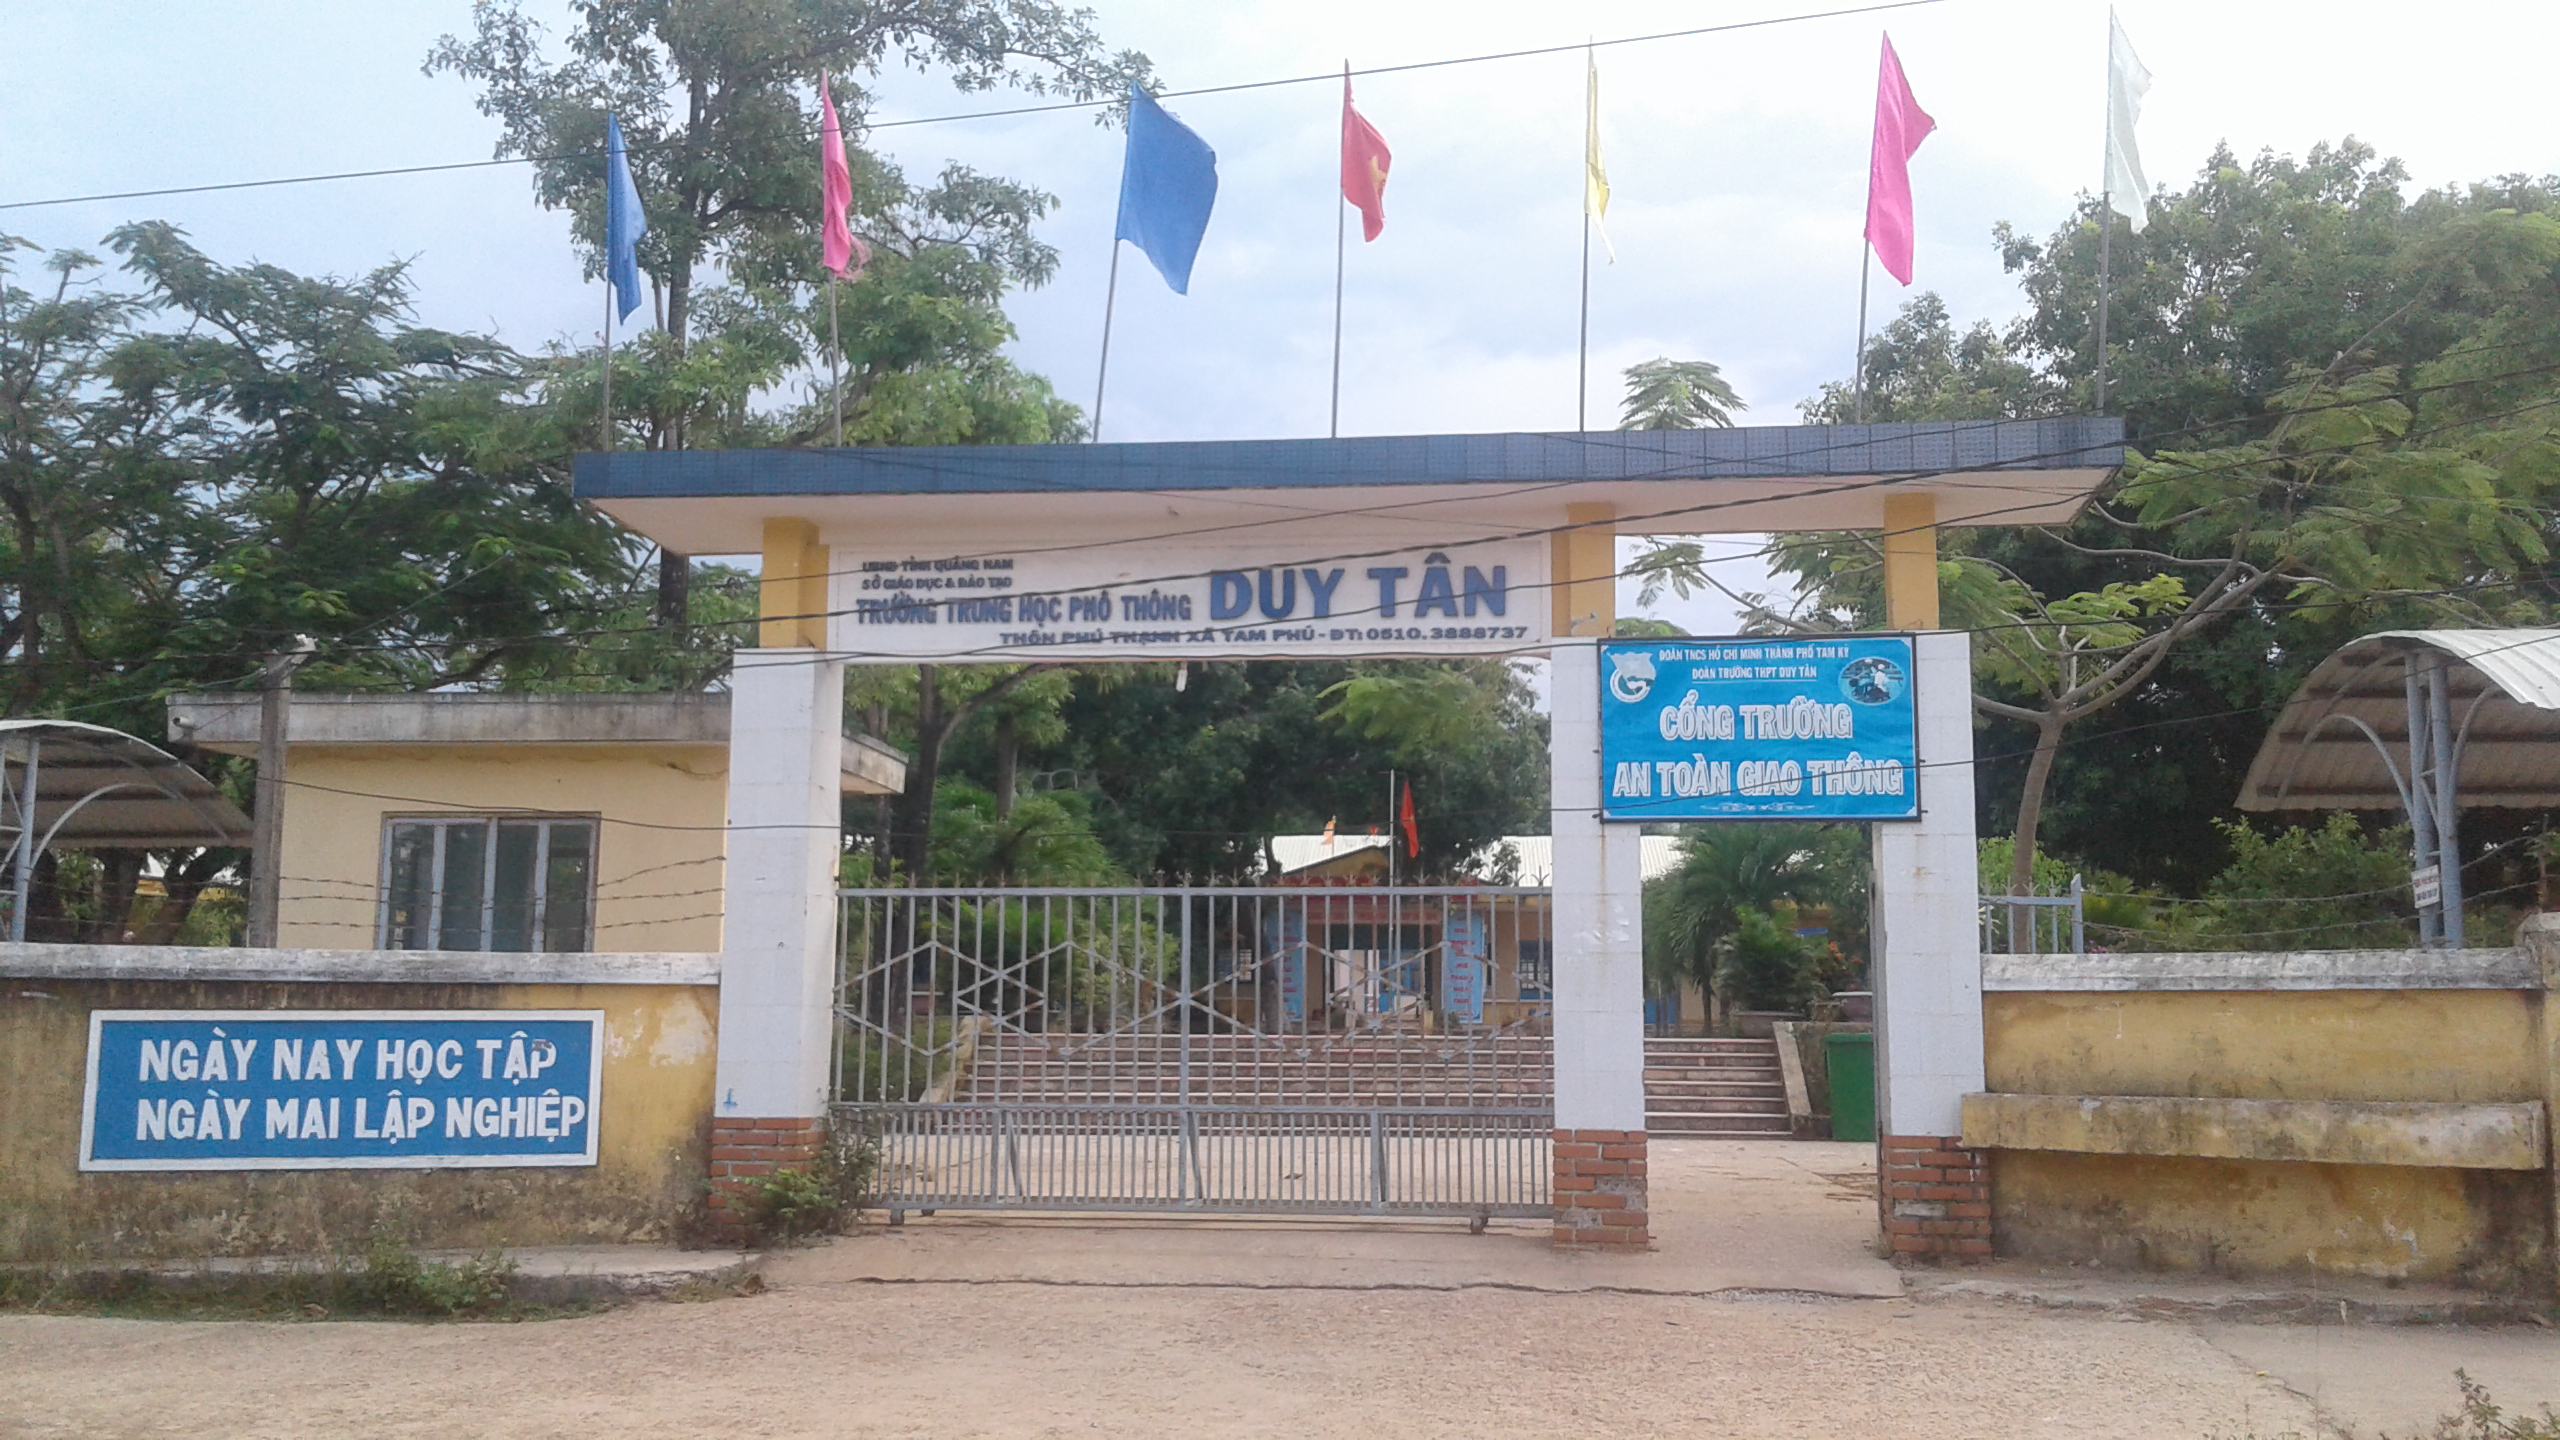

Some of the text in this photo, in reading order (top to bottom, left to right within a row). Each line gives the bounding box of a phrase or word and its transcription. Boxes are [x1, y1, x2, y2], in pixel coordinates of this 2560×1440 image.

[861, 574, 881, 590] SỞ
[916, 577, 943, 591] DỤC
[983, 559, 1013, 570] NAM
[1210, 552, 1506, 620] DUY TÂN
[856, 590, 938, 624] TRƯỜNG
[948, 599, 1012, 624] TRUNG
[1018, 595, 1063, 628] HỌC
[1121, 588, 1192, 621] THÔNG
[1000, 629, 1055, 645] THÔN
[1223, 629, 1266, 642] TAM
[1273, 625, 1314, 641] PHÚ
[1659, 647, 1683, 661] ĐOÀN
[1684, 648, 1707, 661] TNCS
[1740, 648, 1763, 660] MINH
[1765, 646, 1794, 659] THÀNH
[1816, 647, 1836, 659] TAM
[1718, 664, 1753, 679] TRƯỜNG
[1754, 666, 1777, 679] THPT
[1779, 666, 1797, 679] DUY
[1660, 689, 1853, 741] CỔNG TRƯỜNG
[1612, 751, 1904, 797] AN TOÀN GIAO THÔNG
[139, 1026, 557, 1085] NGÀY NAY HỌC TẬP
[136, 1088, 586, 1144] NGÀY MAI LẬP NGHIỆP
